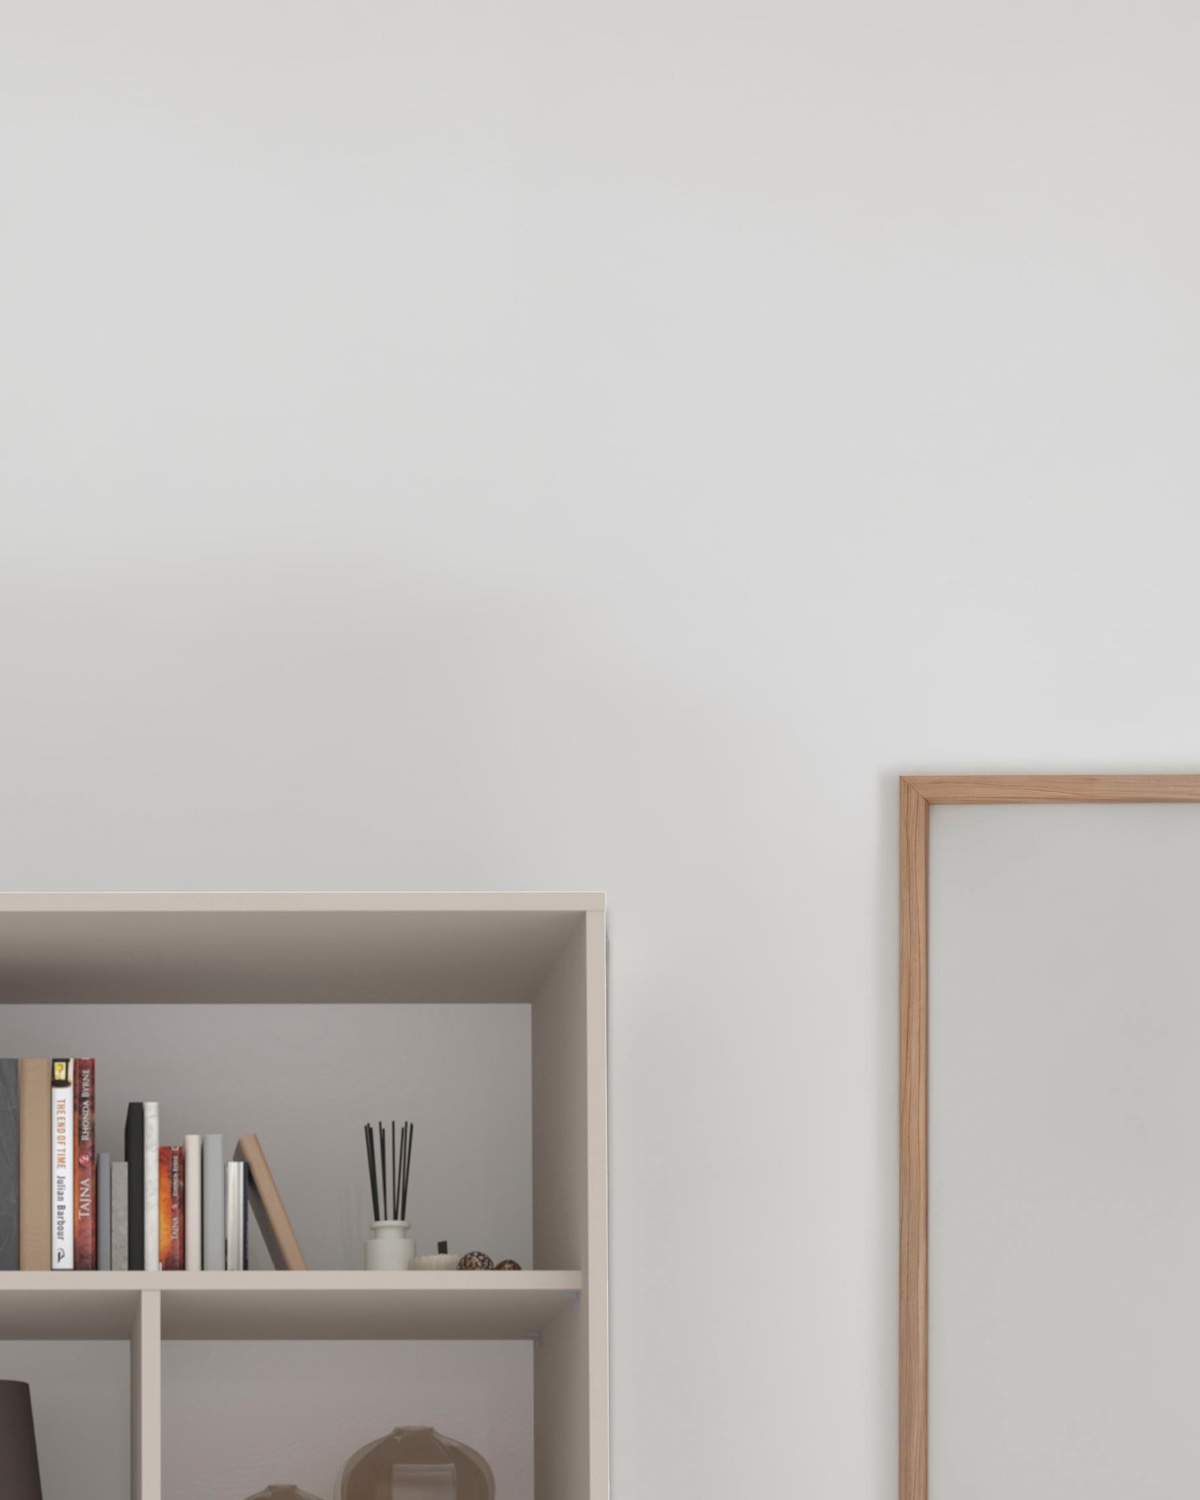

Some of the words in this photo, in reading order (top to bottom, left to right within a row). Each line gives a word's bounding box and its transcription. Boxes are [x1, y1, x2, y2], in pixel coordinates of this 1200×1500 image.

[80, 1069, 90, 1098] BYRNE
[56, 1099, 66, 1116] THE
[56, 1117, 66, 1134] END
[80, 1101, 90, 1141] RHONDA
[56, 1135, 66, 1145] OF
[56, 1148, 66, 1169] TIME
[56, 1176, 66, 1201] Julian
[78, 1178, 91, 1219] TAJNA
[56, 1205, 66, 1241] Barbour
